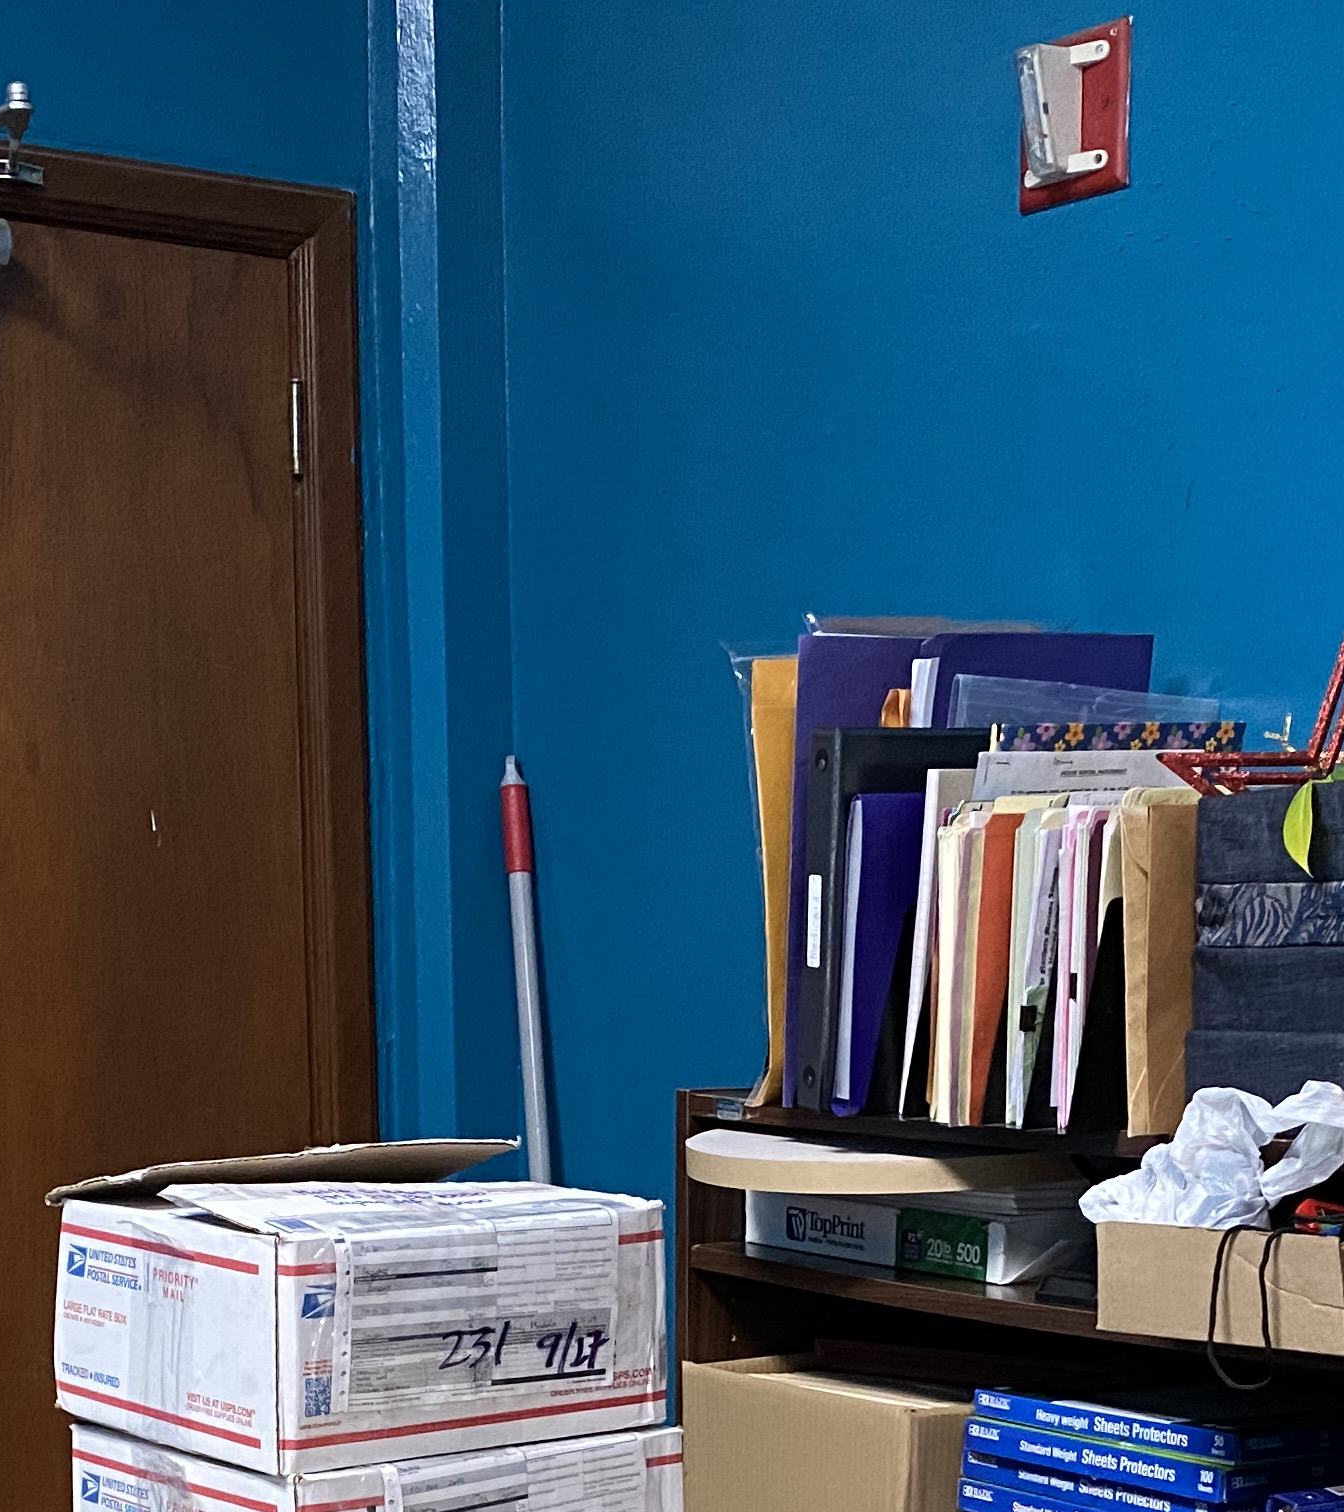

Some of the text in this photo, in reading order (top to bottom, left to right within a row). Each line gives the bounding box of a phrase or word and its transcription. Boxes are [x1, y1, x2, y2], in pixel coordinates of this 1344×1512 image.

[807, 1211, 865, 1241] TopPrint
[88, 1248, 137, 1268] UNITED STATES
[955, 1242, 981, 1265] 500
[87, 1268, 140, 1291] POSTAL SERVICE
[162, 1287, 185, 1302] MAIL
[61, 1362, 89, 1380] TRACKED
[612, 1366, 654, 1382] SPS.COM
[1036, 1408, 1189, 1448] Heavy weight Sheets Protectors
[1019, 1440, 1176, 1482] Standard Weight Sheets Protectors
[1200, 1469, 1214, 1484] 100
[102, 1476, 149, 1500] UNITED STATES
[1078, 1479, 1114, 1500] Sheets
[100, 1497, 123, 1512] POSTAL
